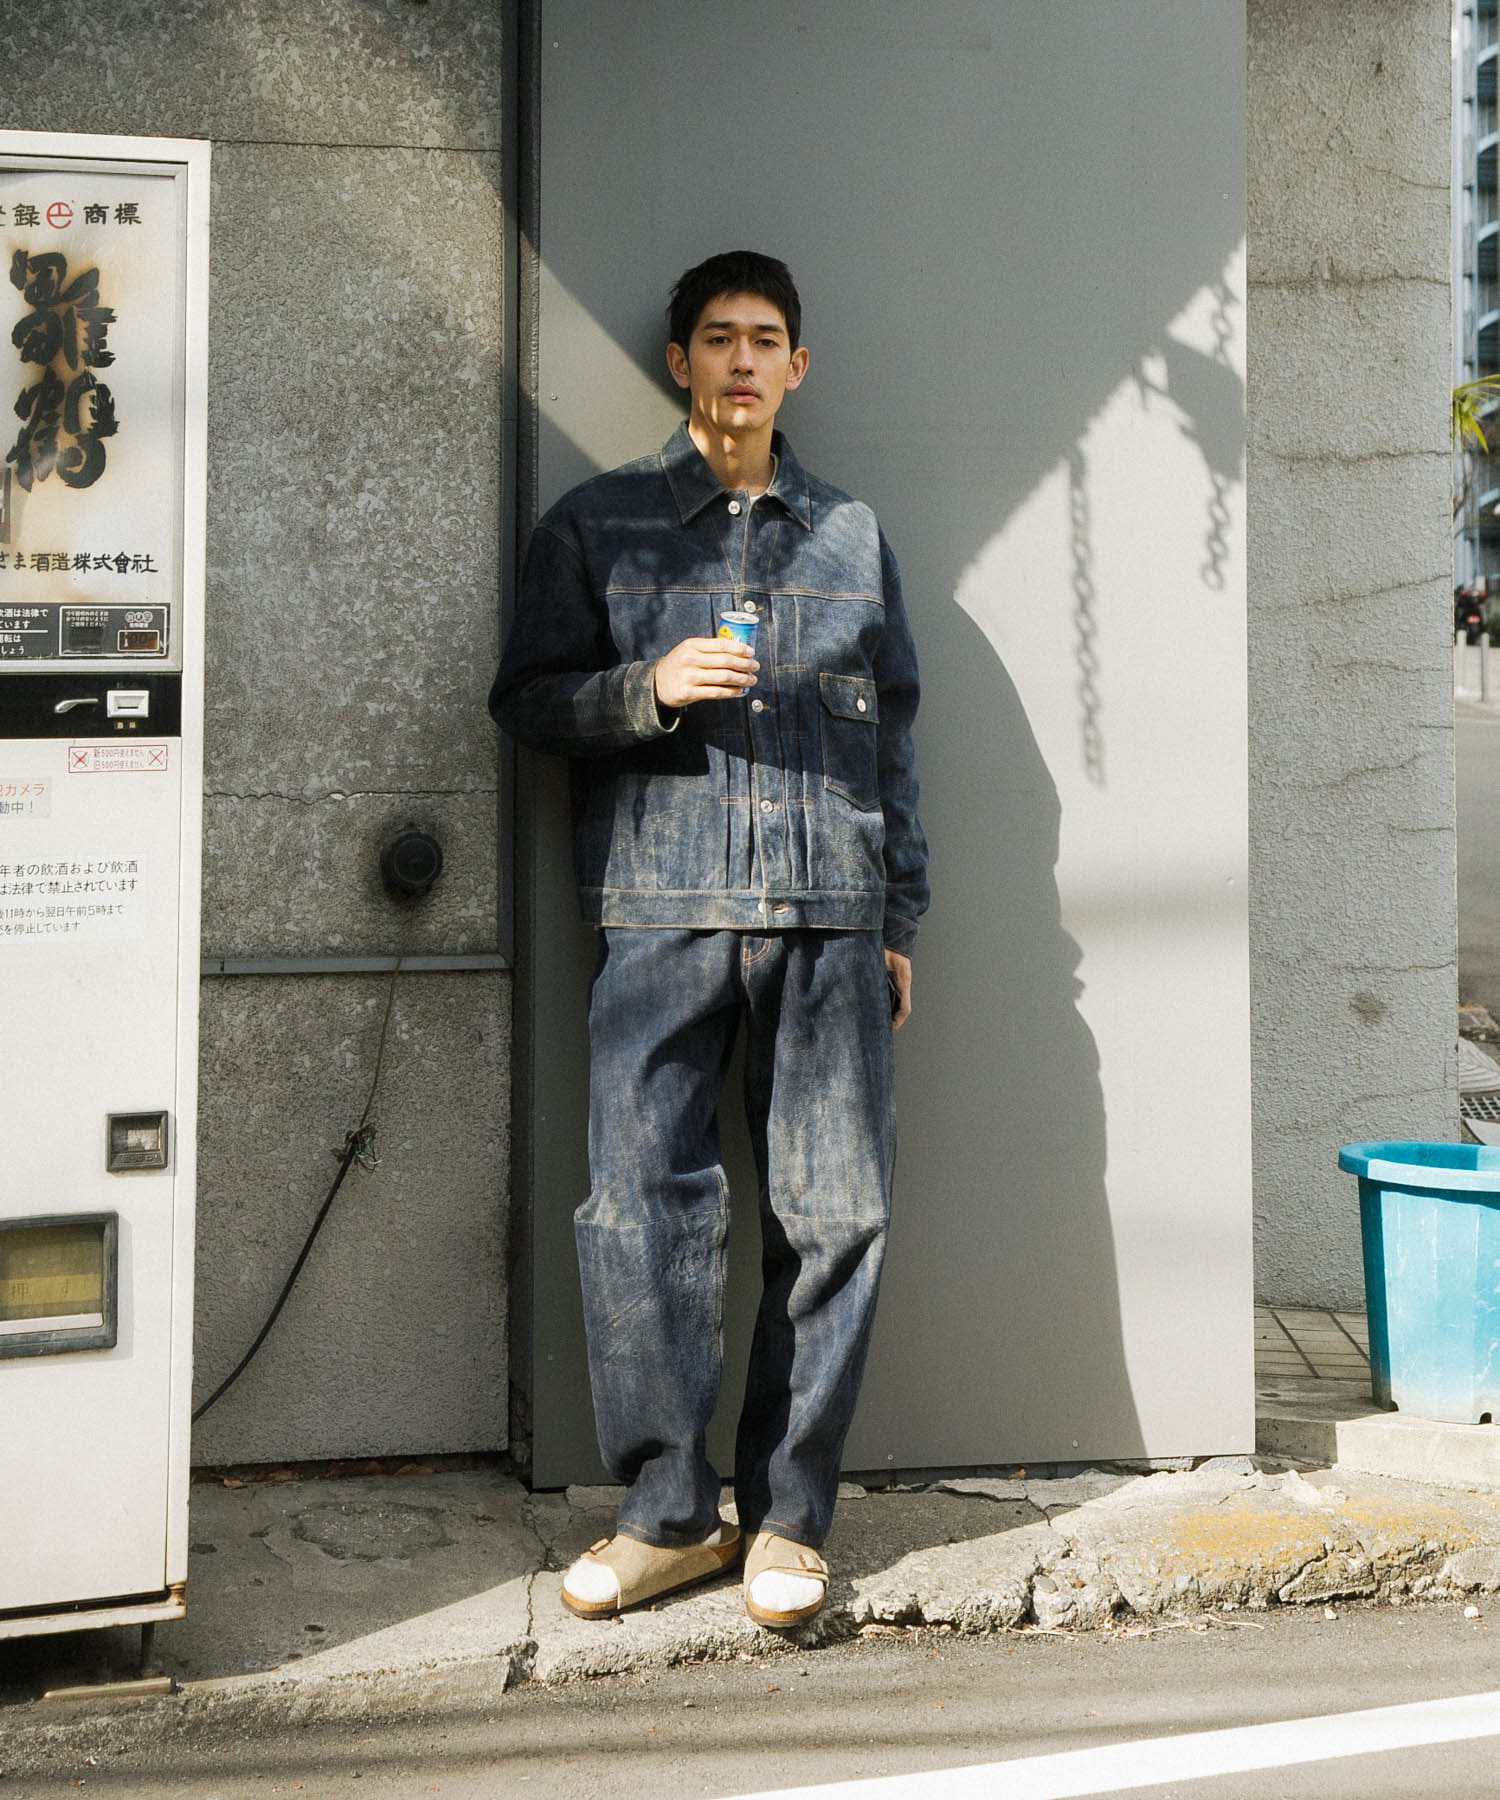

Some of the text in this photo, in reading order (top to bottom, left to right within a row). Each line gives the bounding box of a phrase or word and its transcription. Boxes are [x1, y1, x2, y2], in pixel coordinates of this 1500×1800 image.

[83, 203, 142, 225] 商標
[0, 784, 46, 797] カメラ
[0, 921, 81, 936] を停止しています
